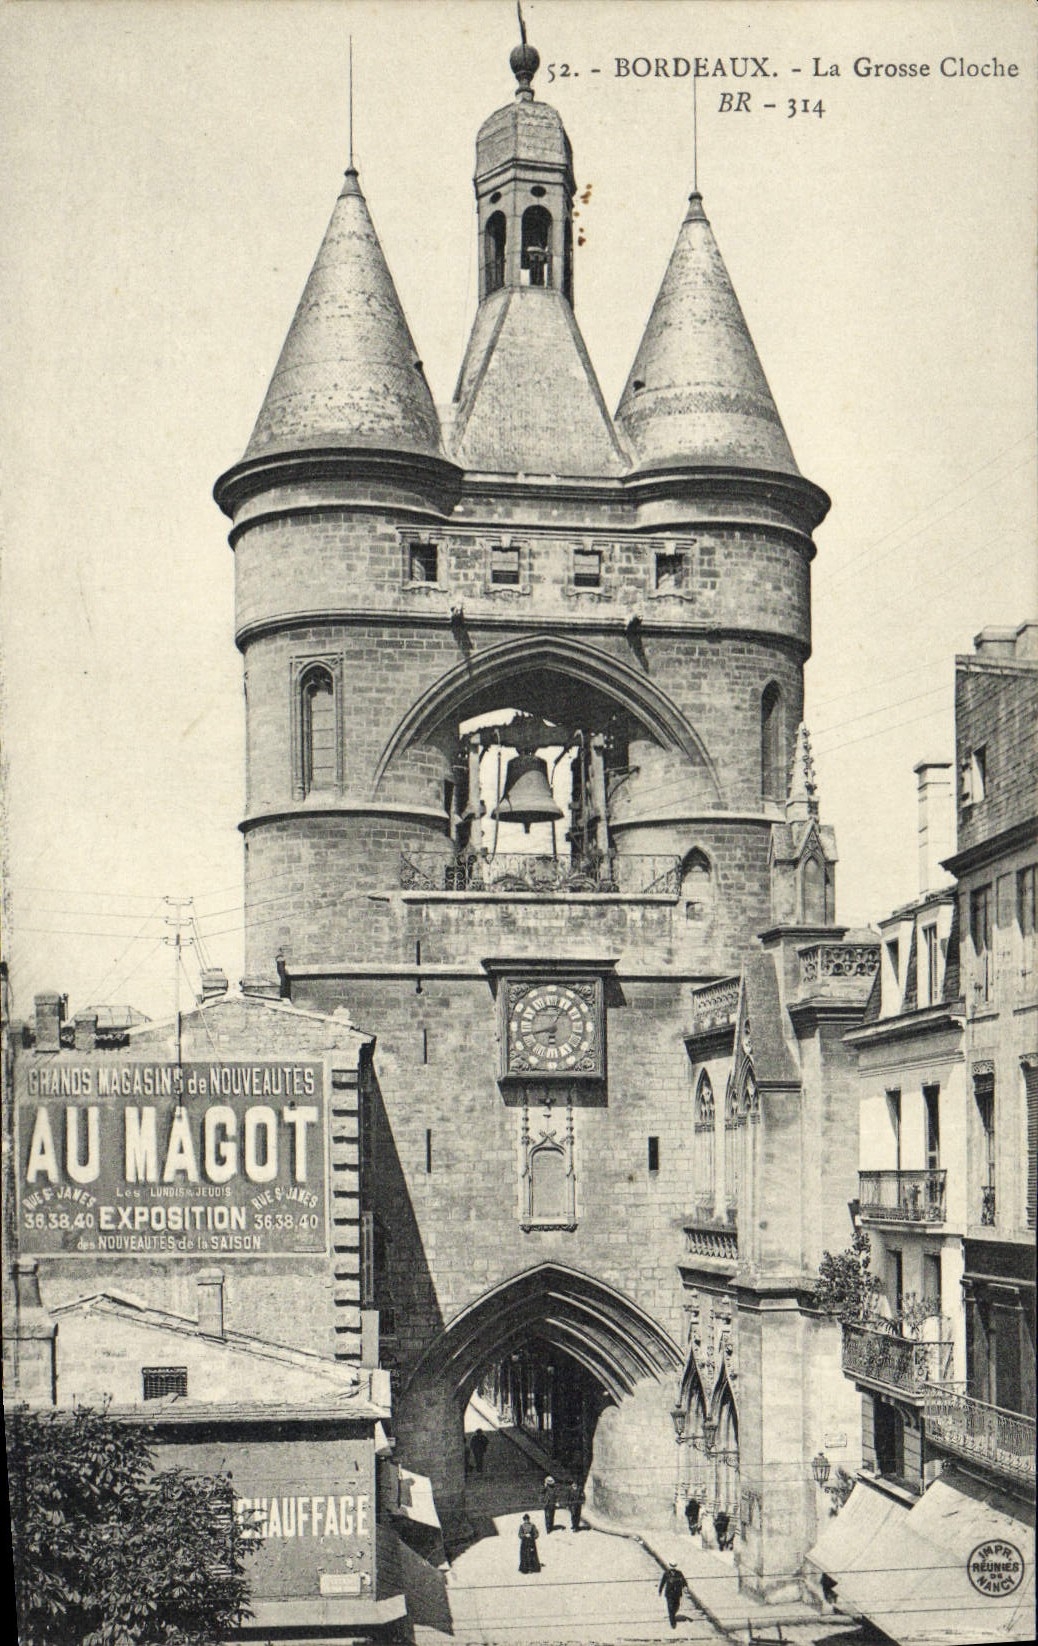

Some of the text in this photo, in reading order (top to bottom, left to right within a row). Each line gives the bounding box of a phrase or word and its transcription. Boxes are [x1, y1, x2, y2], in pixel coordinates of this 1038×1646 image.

[28, 1067, 92, 1095] GRANDS
[98, 1067, 184, 1095] MAGASINS
[188, 1070, 206, 1094] de
[26, 1105, 319, 1183] AU MAGOT
[116, 1187, 141, 1198] Les
[150, 1187, 184, 1198] LUNDIS
[195, 1187, 231, 1198] JEUDIS
[251, 1190, 274, 1210] RUE
[99, 1206, 246, 1230] EXPOSITION
[178, 1237, 194, 1250] de
[197, 1237, 208, 1250] la
[210, 1236, 261, 1250] SAISON
